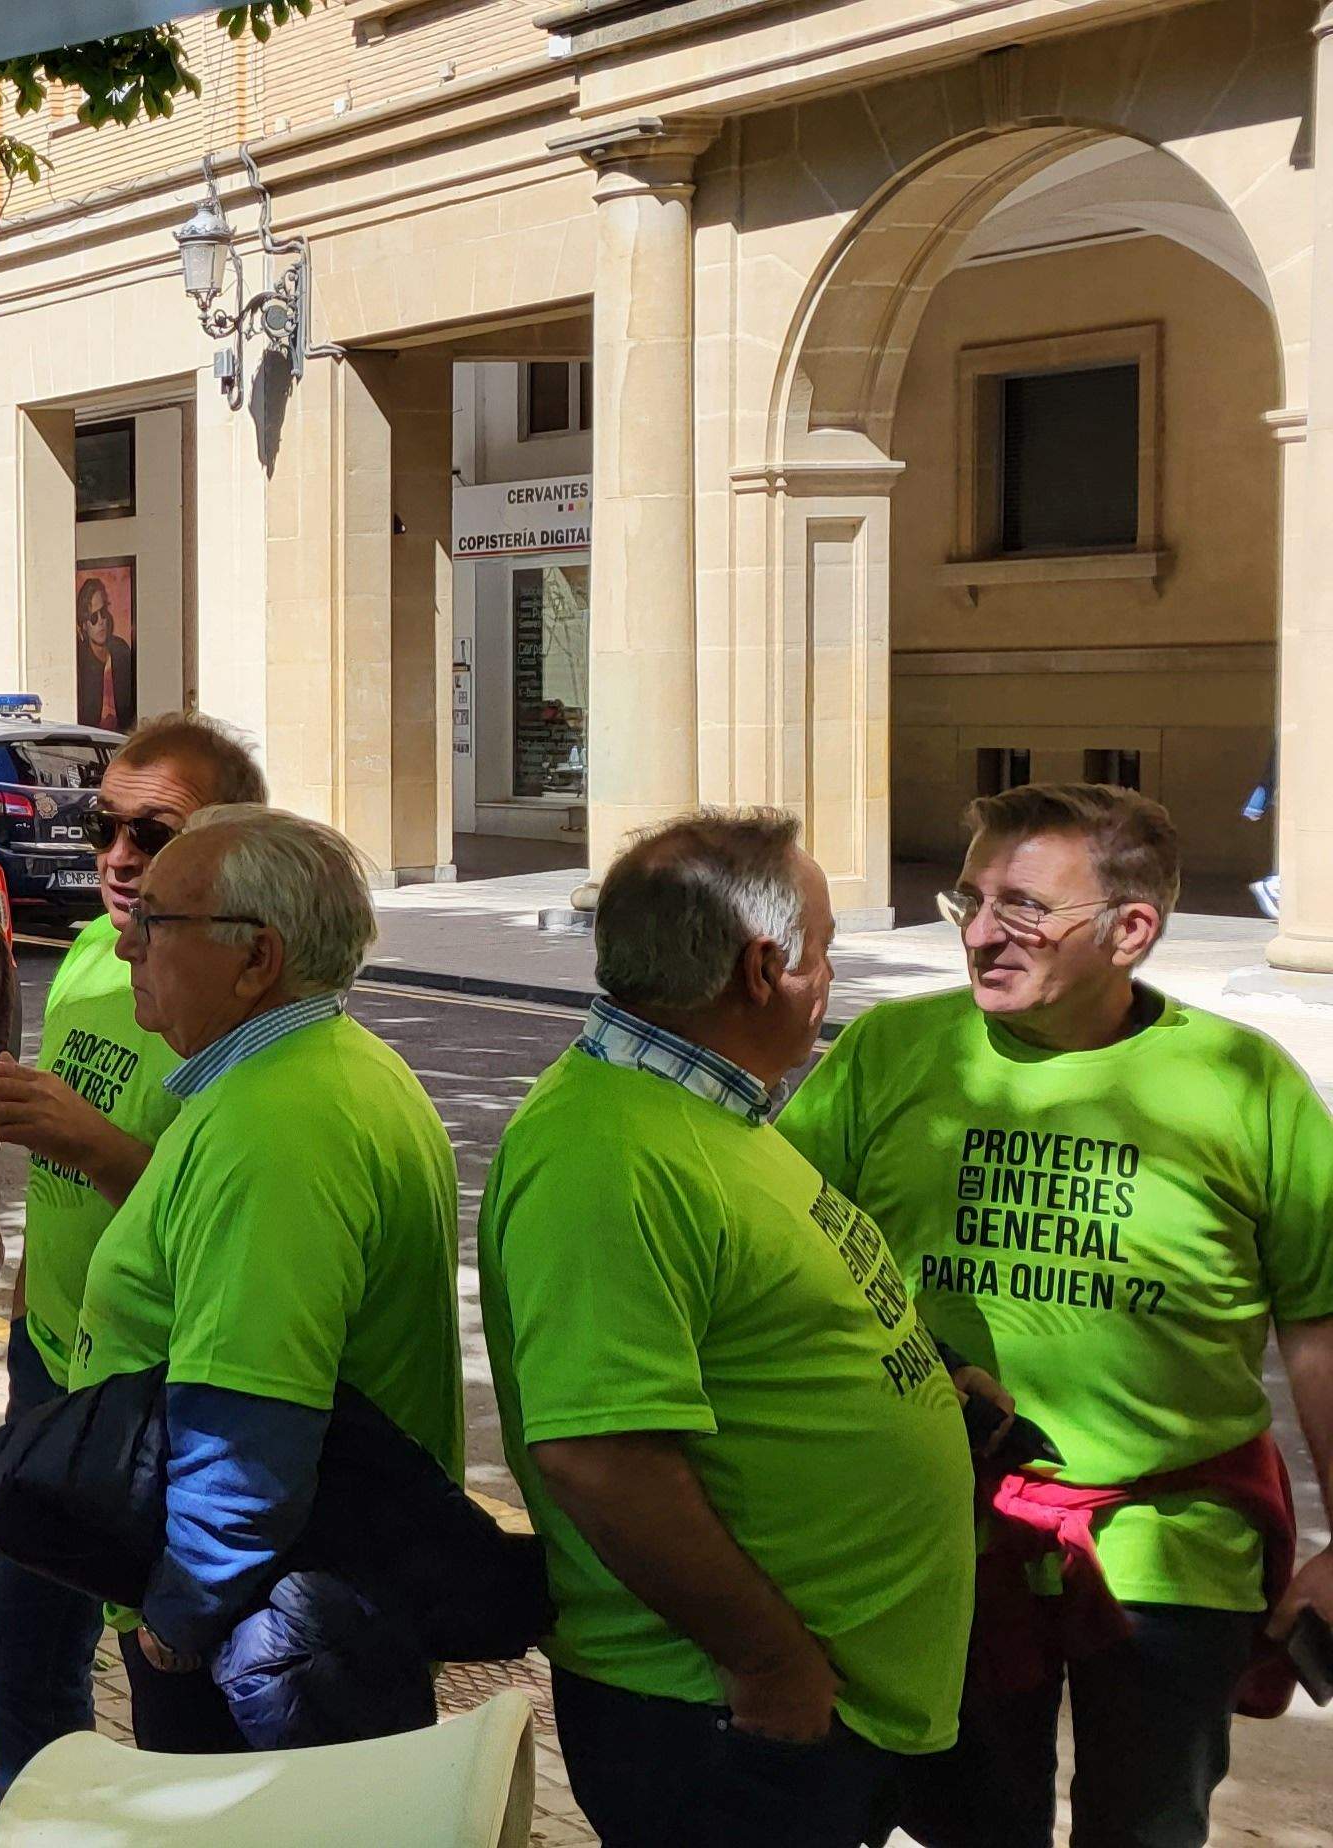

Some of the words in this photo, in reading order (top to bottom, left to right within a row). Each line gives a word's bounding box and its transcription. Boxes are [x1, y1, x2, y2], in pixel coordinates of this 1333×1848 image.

[507, 483, 589, 504] CERVANTES
[458, 528, 536, 550] COPISTERÍA
[540, 527, 591, 545] DIGITAL
[59, 1028, 139, 1083] PROYECTO
[962, 1128, 1140, 1179] PROYECTO
[990, 1167, 1136, 1219] INTERES
[956, 1205, 1129, 1264] GENERAL
[922, 1254, 999, 1297] PARA
[1009, 1263, 1115, 1311] QUIEN
[1125, 1277, 1166, 1315] ??
